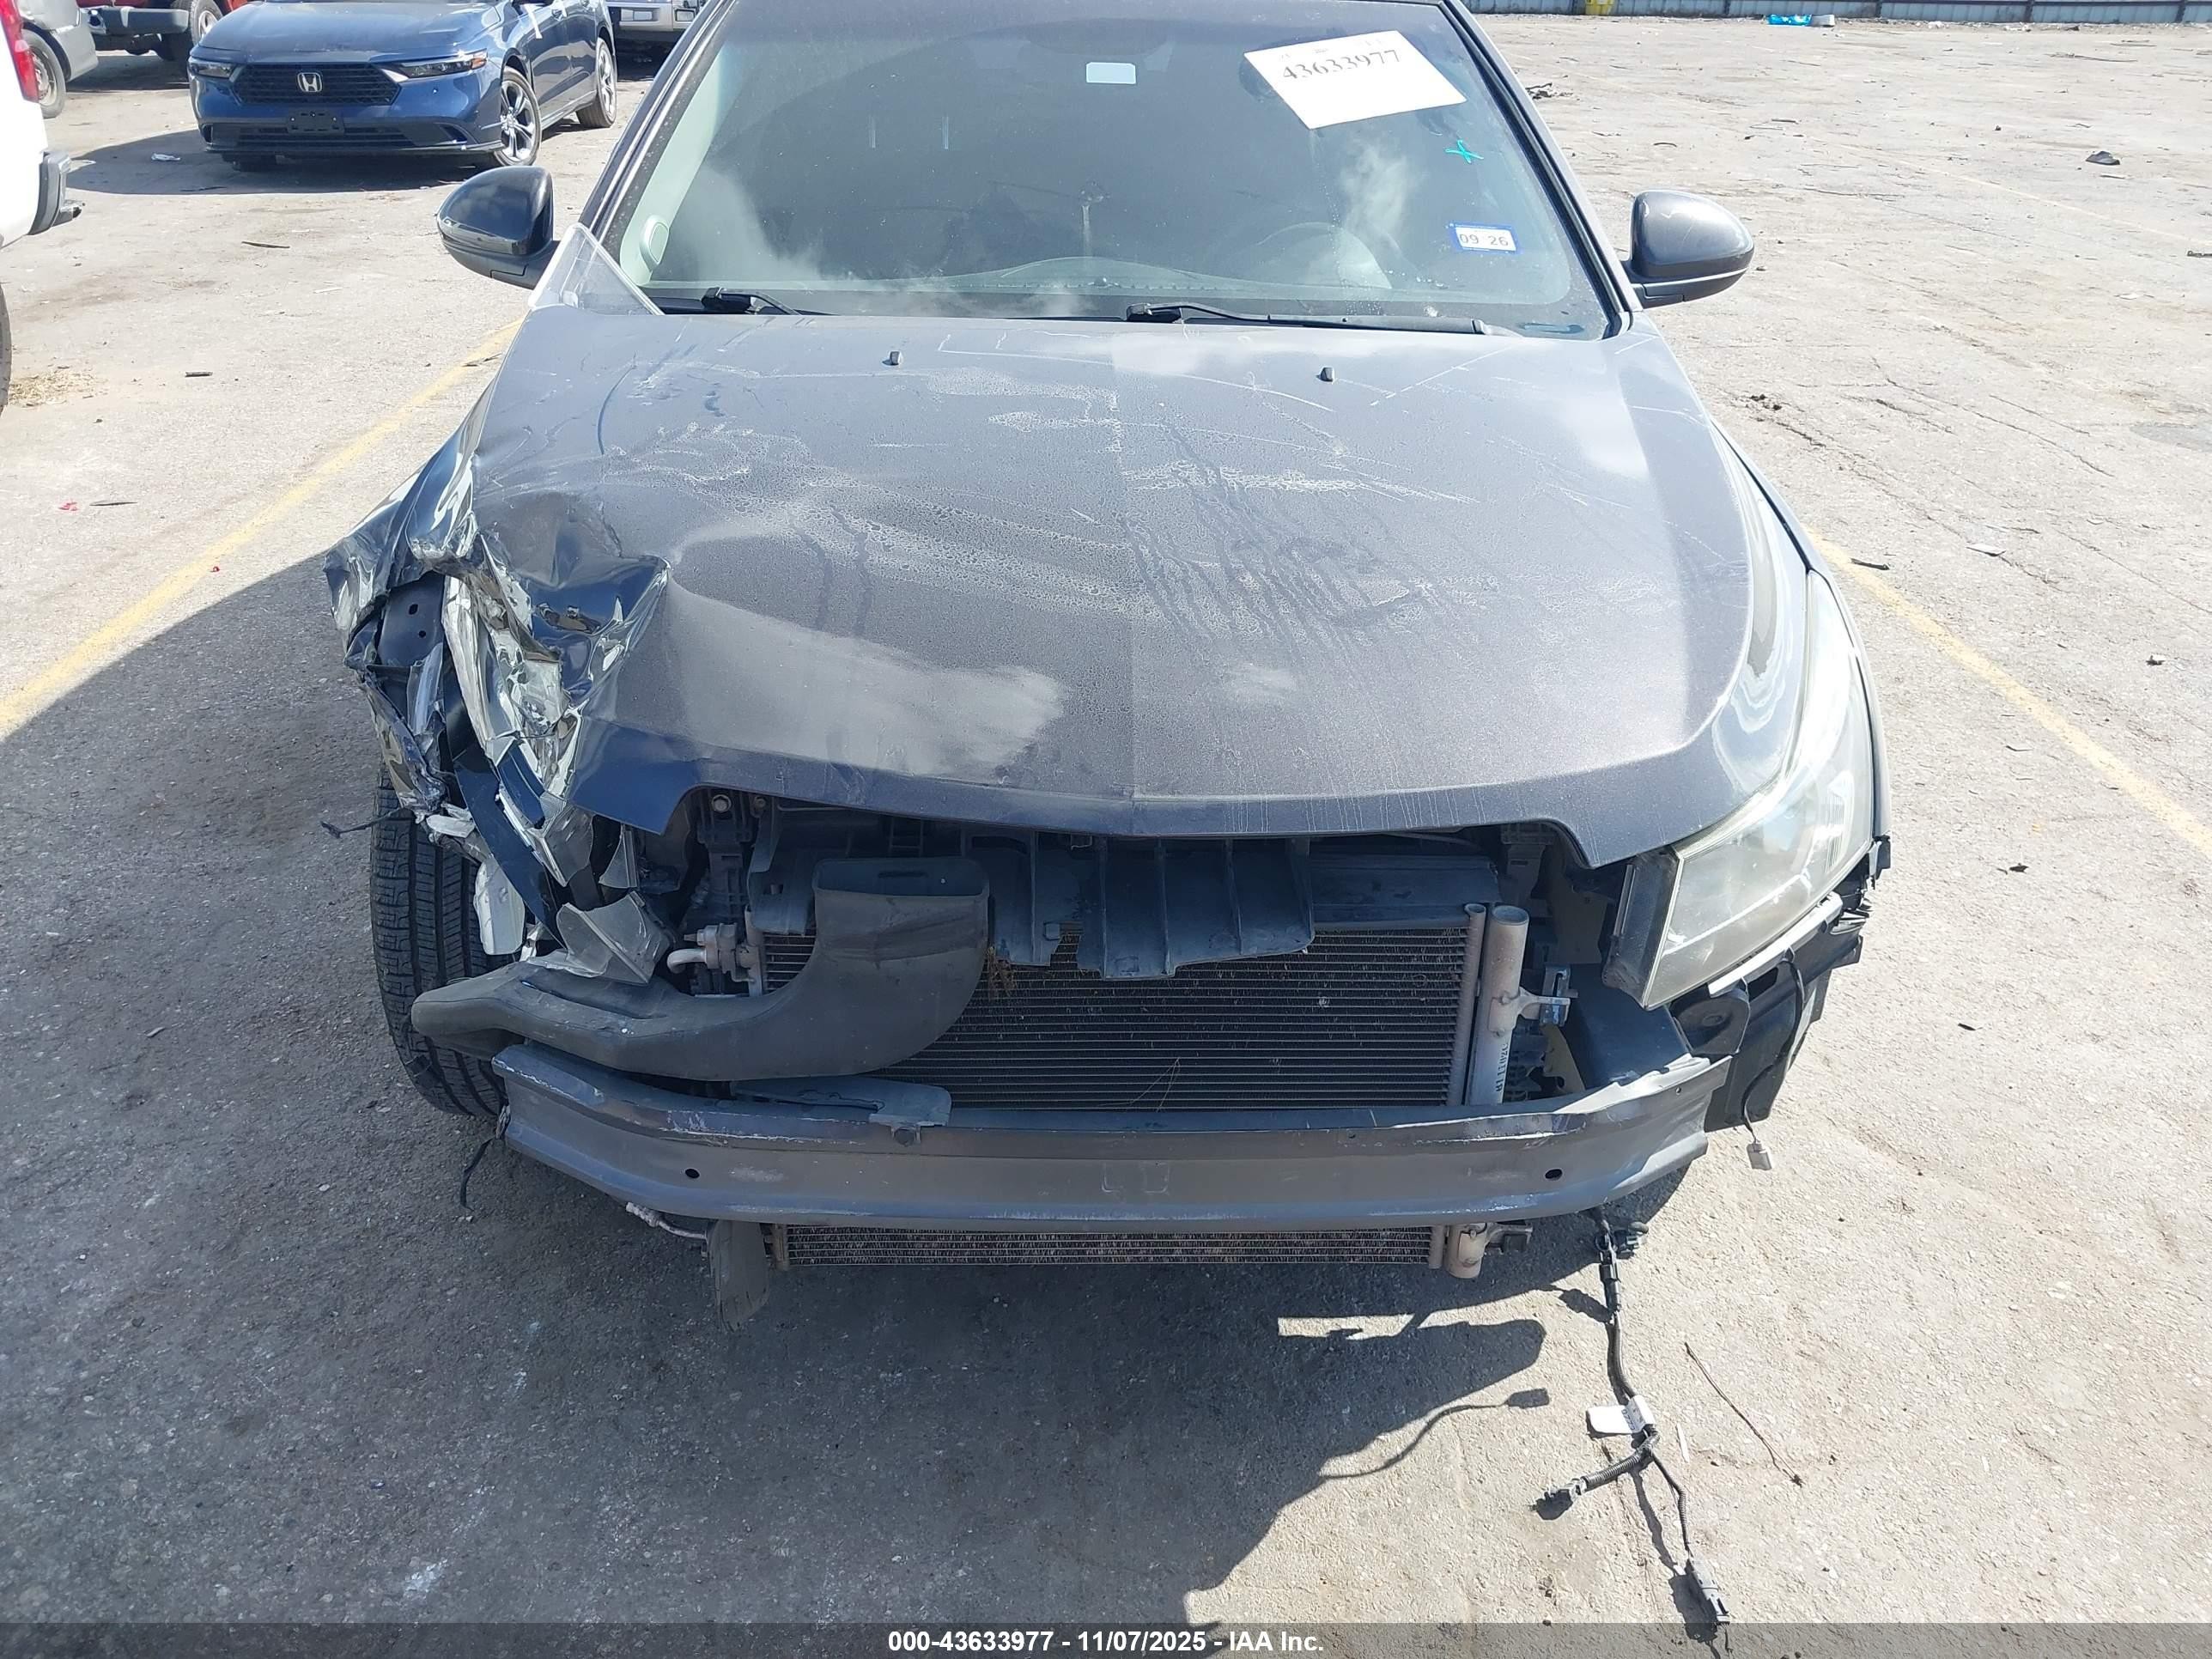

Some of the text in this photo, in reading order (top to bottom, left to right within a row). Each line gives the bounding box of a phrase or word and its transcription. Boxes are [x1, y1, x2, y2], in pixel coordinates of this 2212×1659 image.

[1283, 49, 1400, 79] 43633977
[1459, 233, 1509, 247] 09 26
